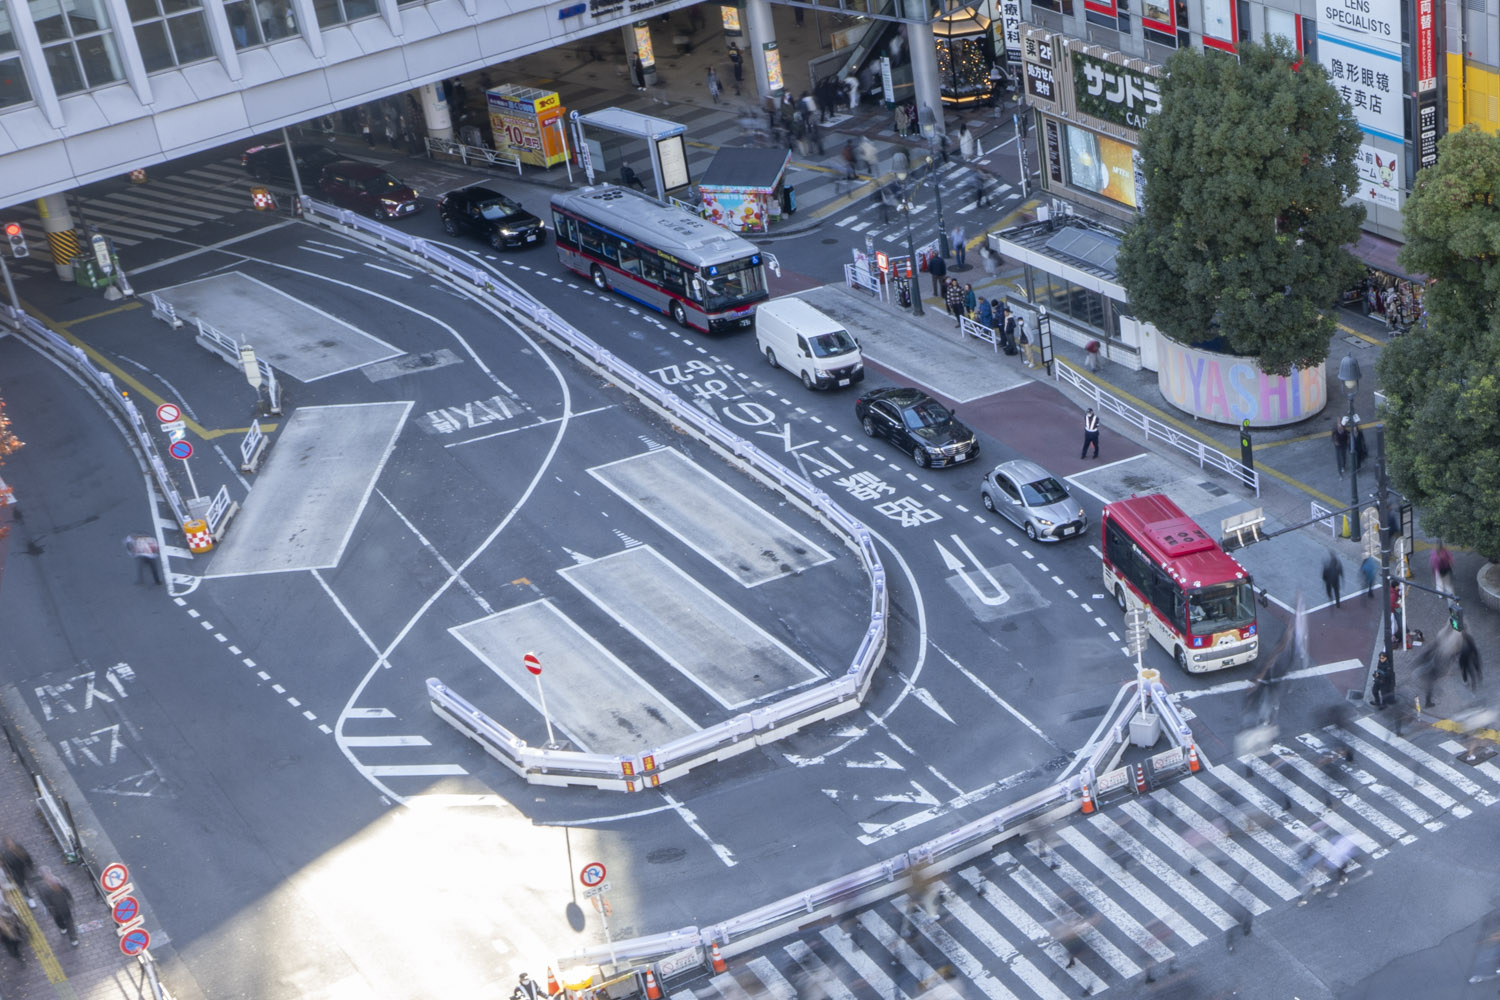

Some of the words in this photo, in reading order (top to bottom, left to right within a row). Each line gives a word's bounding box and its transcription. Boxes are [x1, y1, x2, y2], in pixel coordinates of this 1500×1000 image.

[1344, 0, 1370, 13] LENS
[1326, 6, 1391, 36] SPECIALISTS
[1027, 63, 1055, 83] 処方せん
[1331, 58, 1390, 93] 隐形眼镜
[1035, 80, 1050, 96] 受付
[1422, 80, 1433, 90] 7F
[1341, 85, 1382, 114] 专卖店
[650, 359, 716, 385] 6-22
